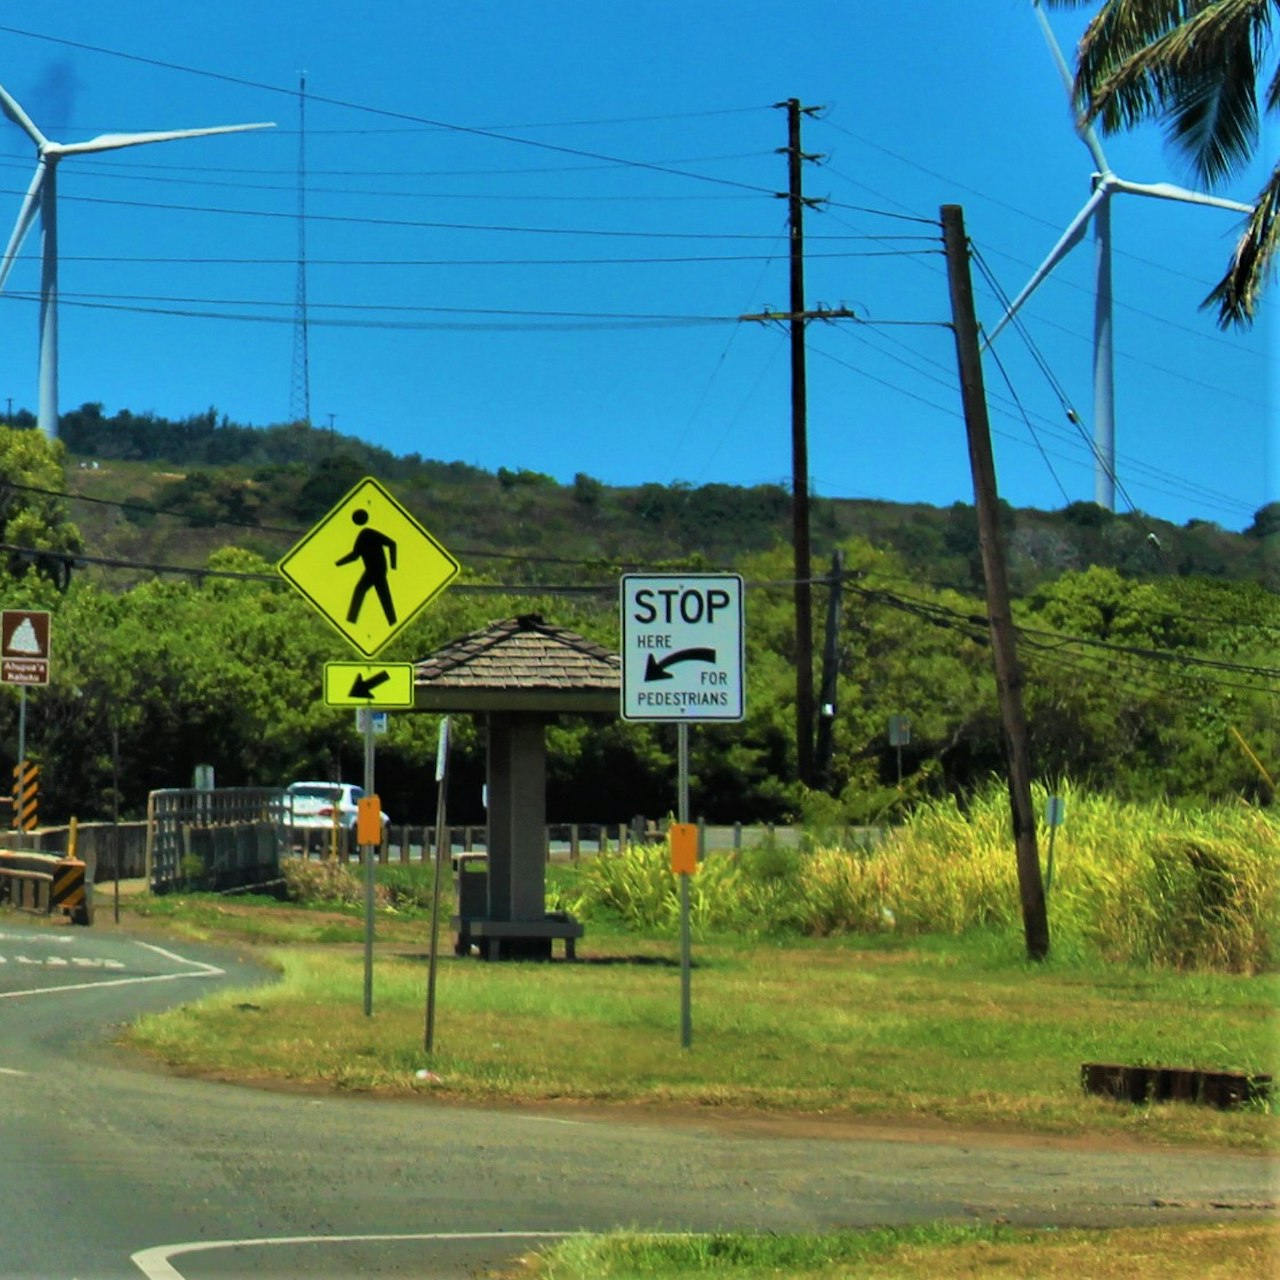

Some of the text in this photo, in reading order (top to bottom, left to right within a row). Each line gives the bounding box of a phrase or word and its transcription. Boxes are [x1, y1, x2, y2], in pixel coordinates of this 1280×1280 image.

[634, 589, 730, 624] STOP
[637, 635, 672, 648] HERE
[700, 671, 728, 686] FOR
[637, 691, 728, 706] PEDESTRIANS
